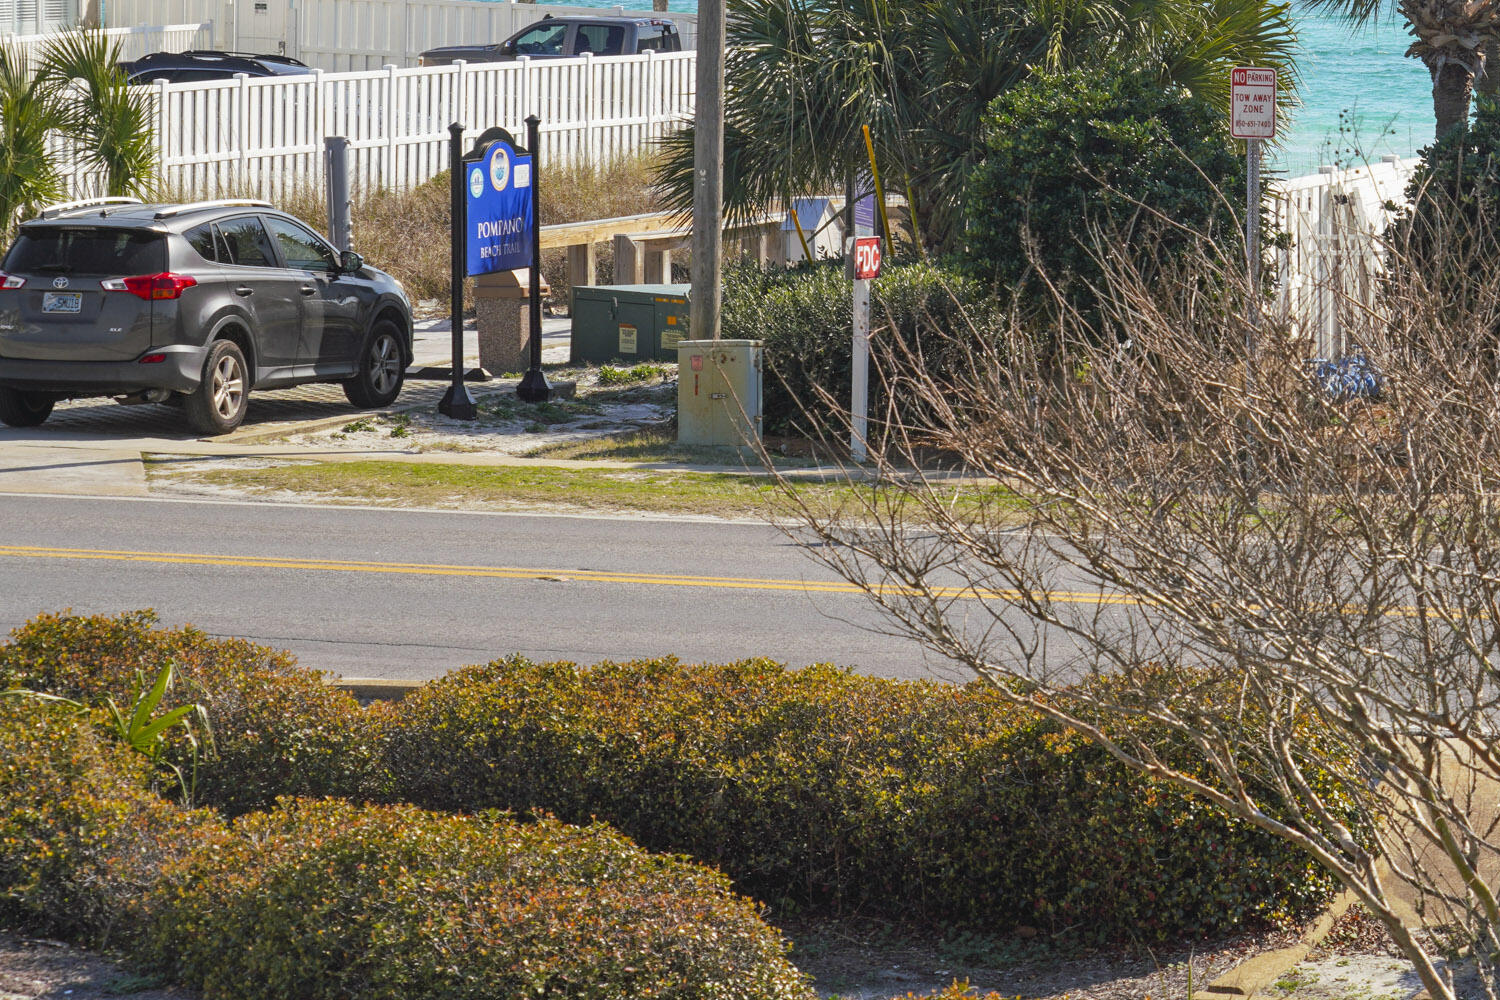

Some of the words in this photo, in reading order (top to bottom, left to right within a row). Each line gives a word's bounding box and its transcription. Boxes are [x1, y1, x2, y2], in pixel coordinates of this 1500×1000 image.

[1234, 72, 1245, 83] NO
[1247, 73, 1272, 82] PARKING
[1235, 93, 1250, 102] TOW
[1253, 93, 1272, 102] AWAY
[1243, 104, 1264, 113] ZONE
[477, 217, 523, 239] POMPANO
[480, 244, 502, 258] BEACH
[503, 242, 521, 256] TRAIL
[856, 245, 880, 272] FDC
